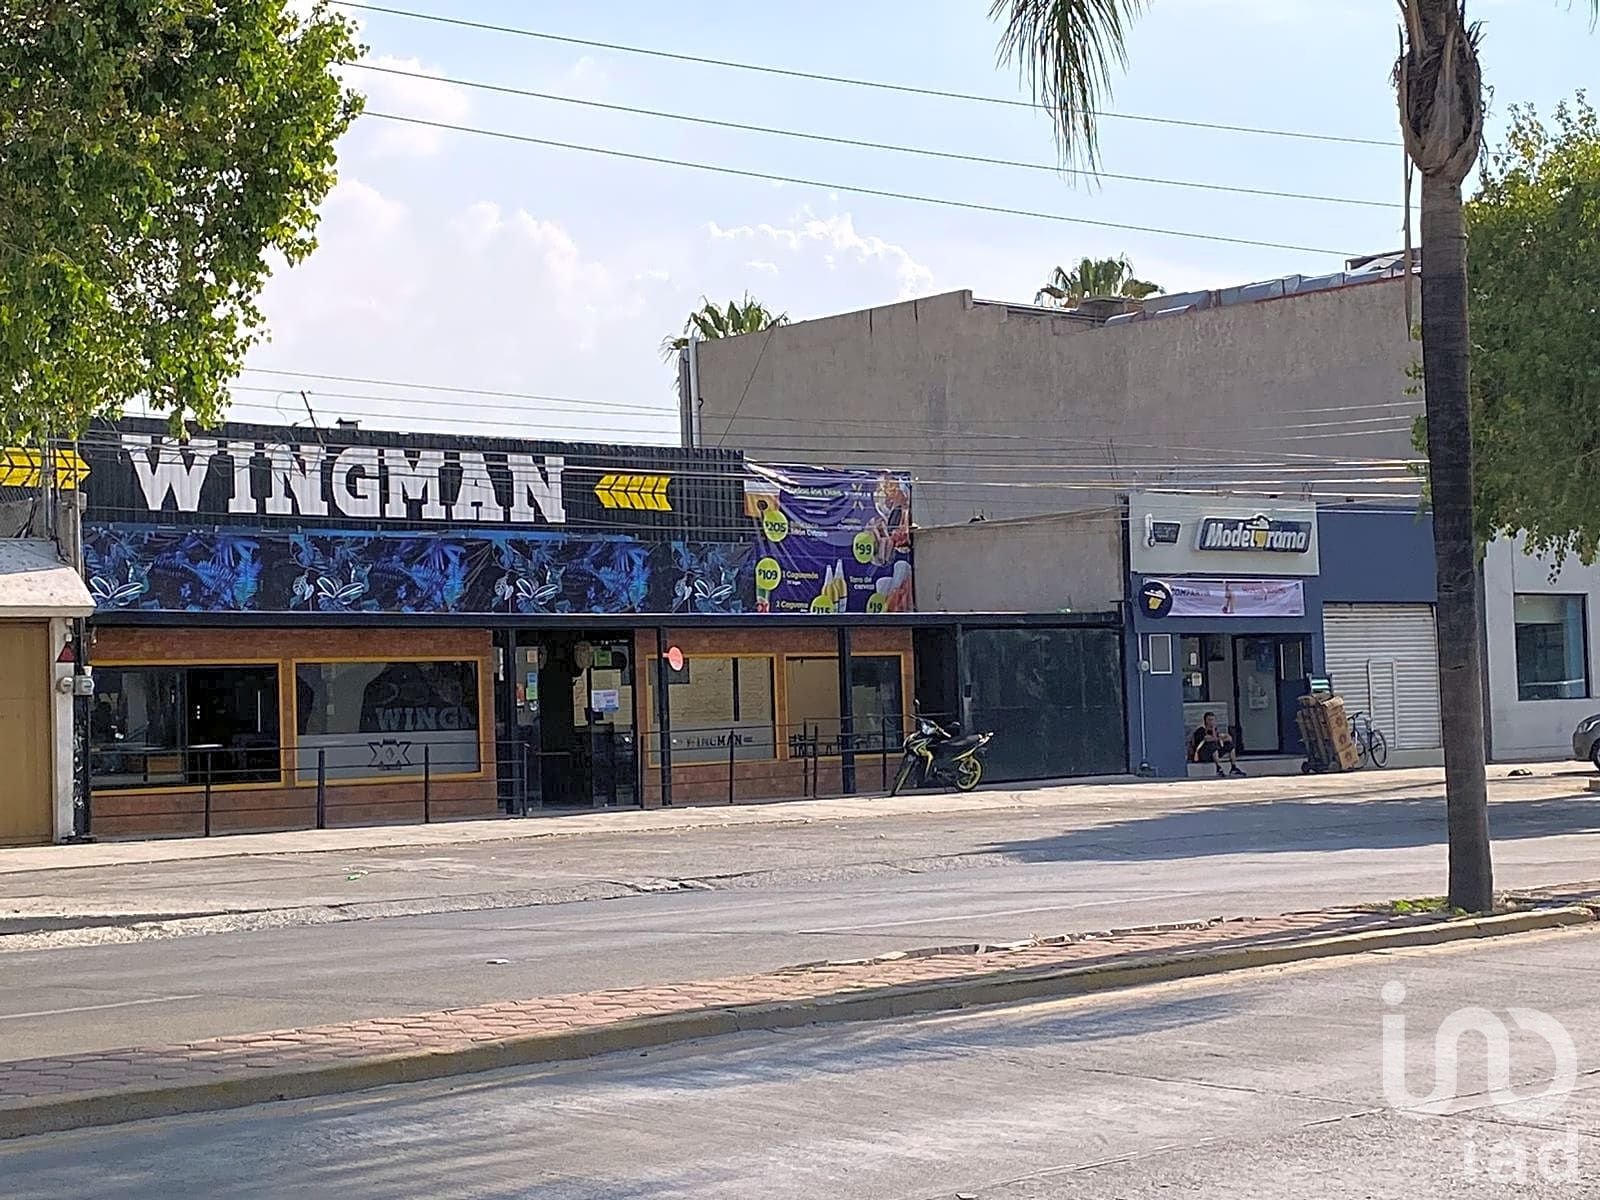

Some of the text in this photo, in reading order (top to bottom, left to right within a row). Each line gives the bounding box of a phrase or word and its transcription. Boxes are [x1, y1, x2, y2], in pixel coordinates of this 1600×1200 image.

[121, 433, 566, 523] WINGMAN
[855, 543, 872, 556] $99
[758, 568, 778, 581] $109
